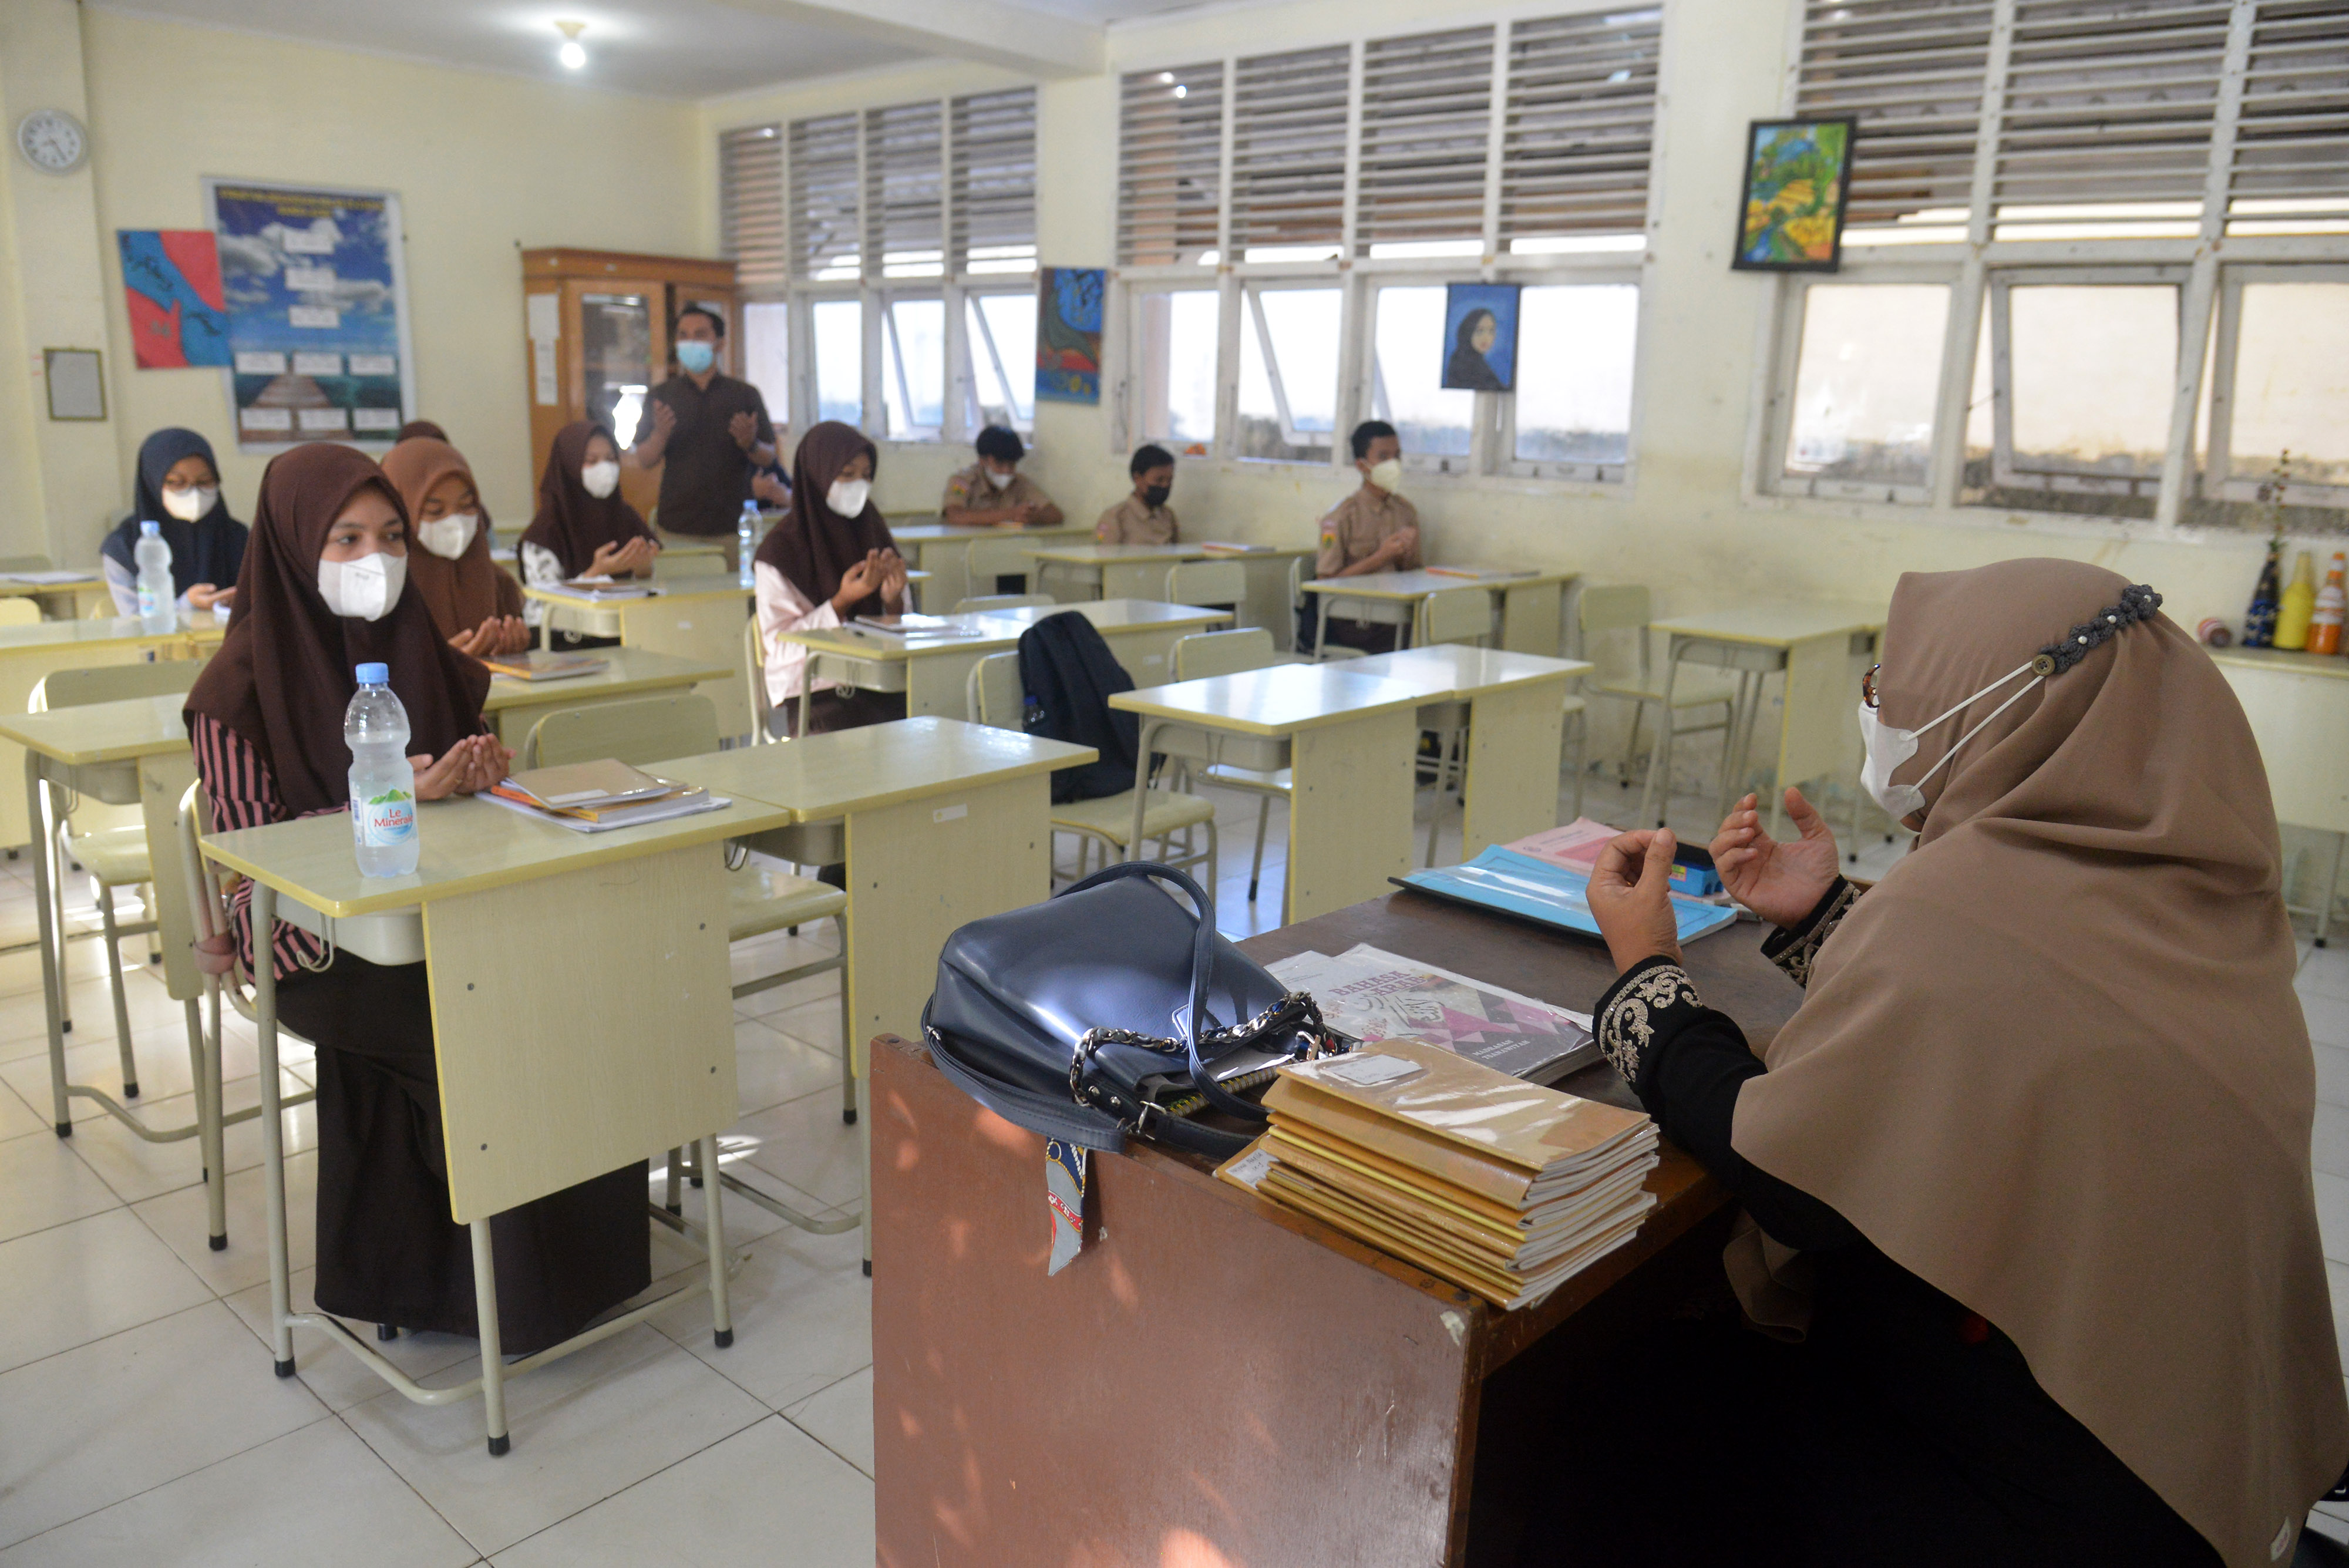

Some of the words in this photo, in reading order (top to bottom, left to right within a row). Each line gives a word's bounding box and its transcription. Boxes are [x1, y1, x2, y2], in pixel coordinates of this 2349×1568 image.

[389, 809, 402, 819] Le
[1328, 971, 1411, 996] BAHASA
[1371, 976, 1426, 997] ARAB
[1472, 1039, 1513, 1056] MADRASAH
